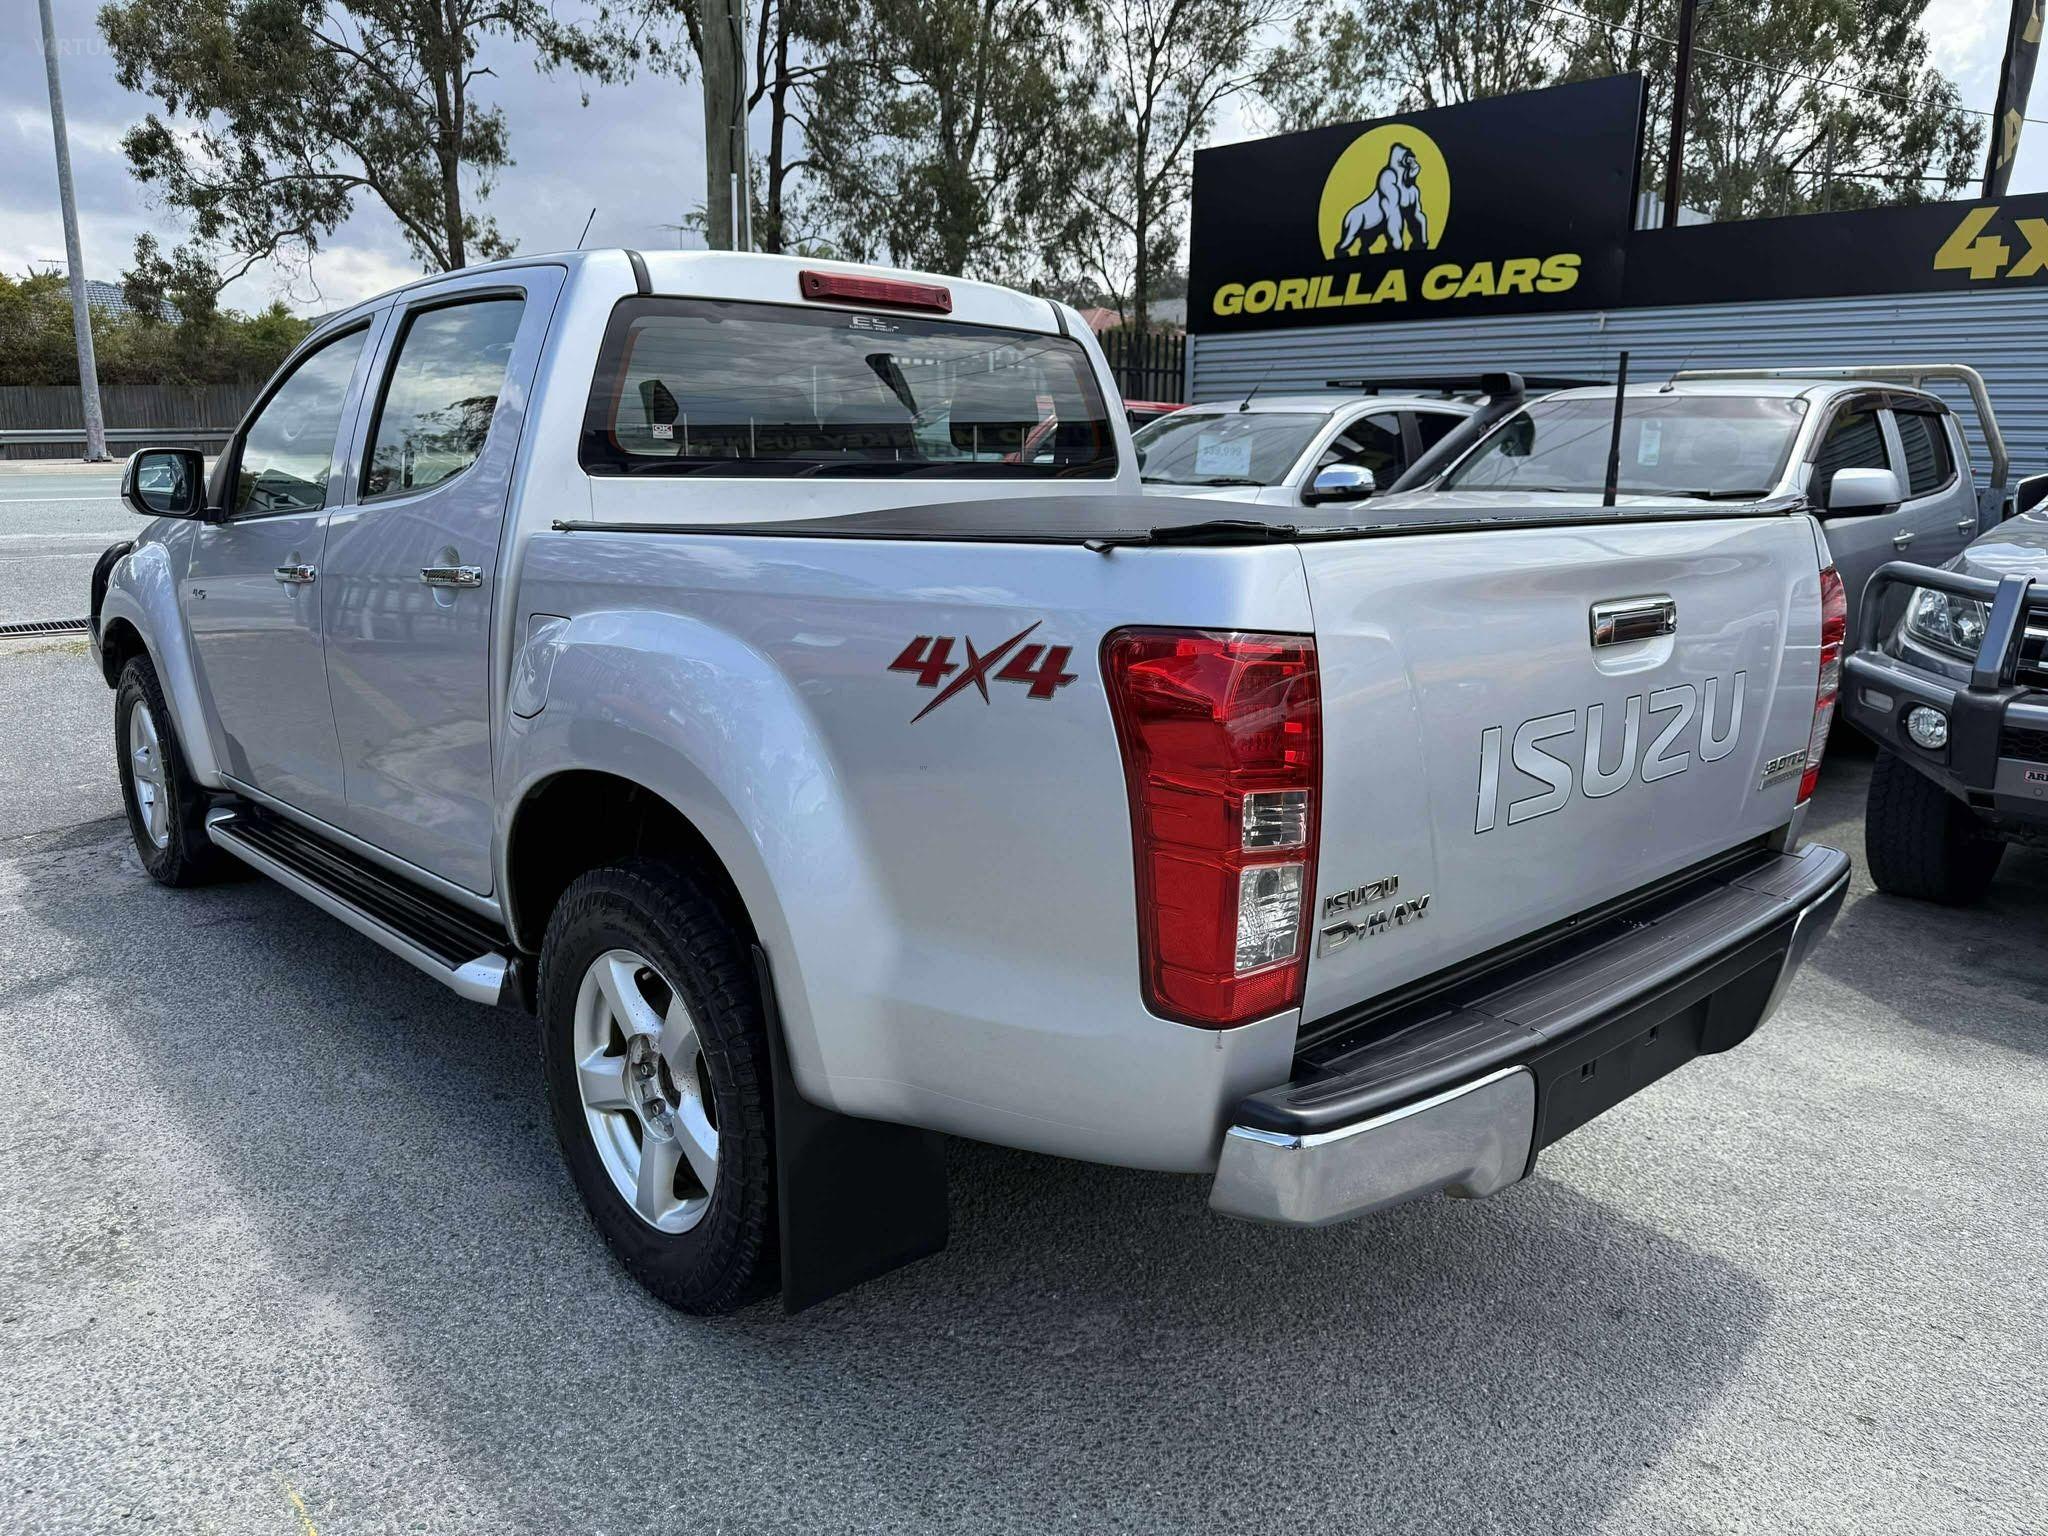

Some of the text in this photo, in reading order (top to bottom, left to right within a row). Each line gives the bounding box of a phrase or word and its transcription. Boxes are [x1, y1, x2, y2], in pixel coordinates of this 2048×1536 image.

[1212, 252, 1582, 316] GORILLA CARS
[1475, 670, 1746, 834] ISUZU
[2027, 770, 2048, 782] AR
[1317, 893, 1431, 959] D-MAX
[1322, 874, 1399, 919] ISUZU
